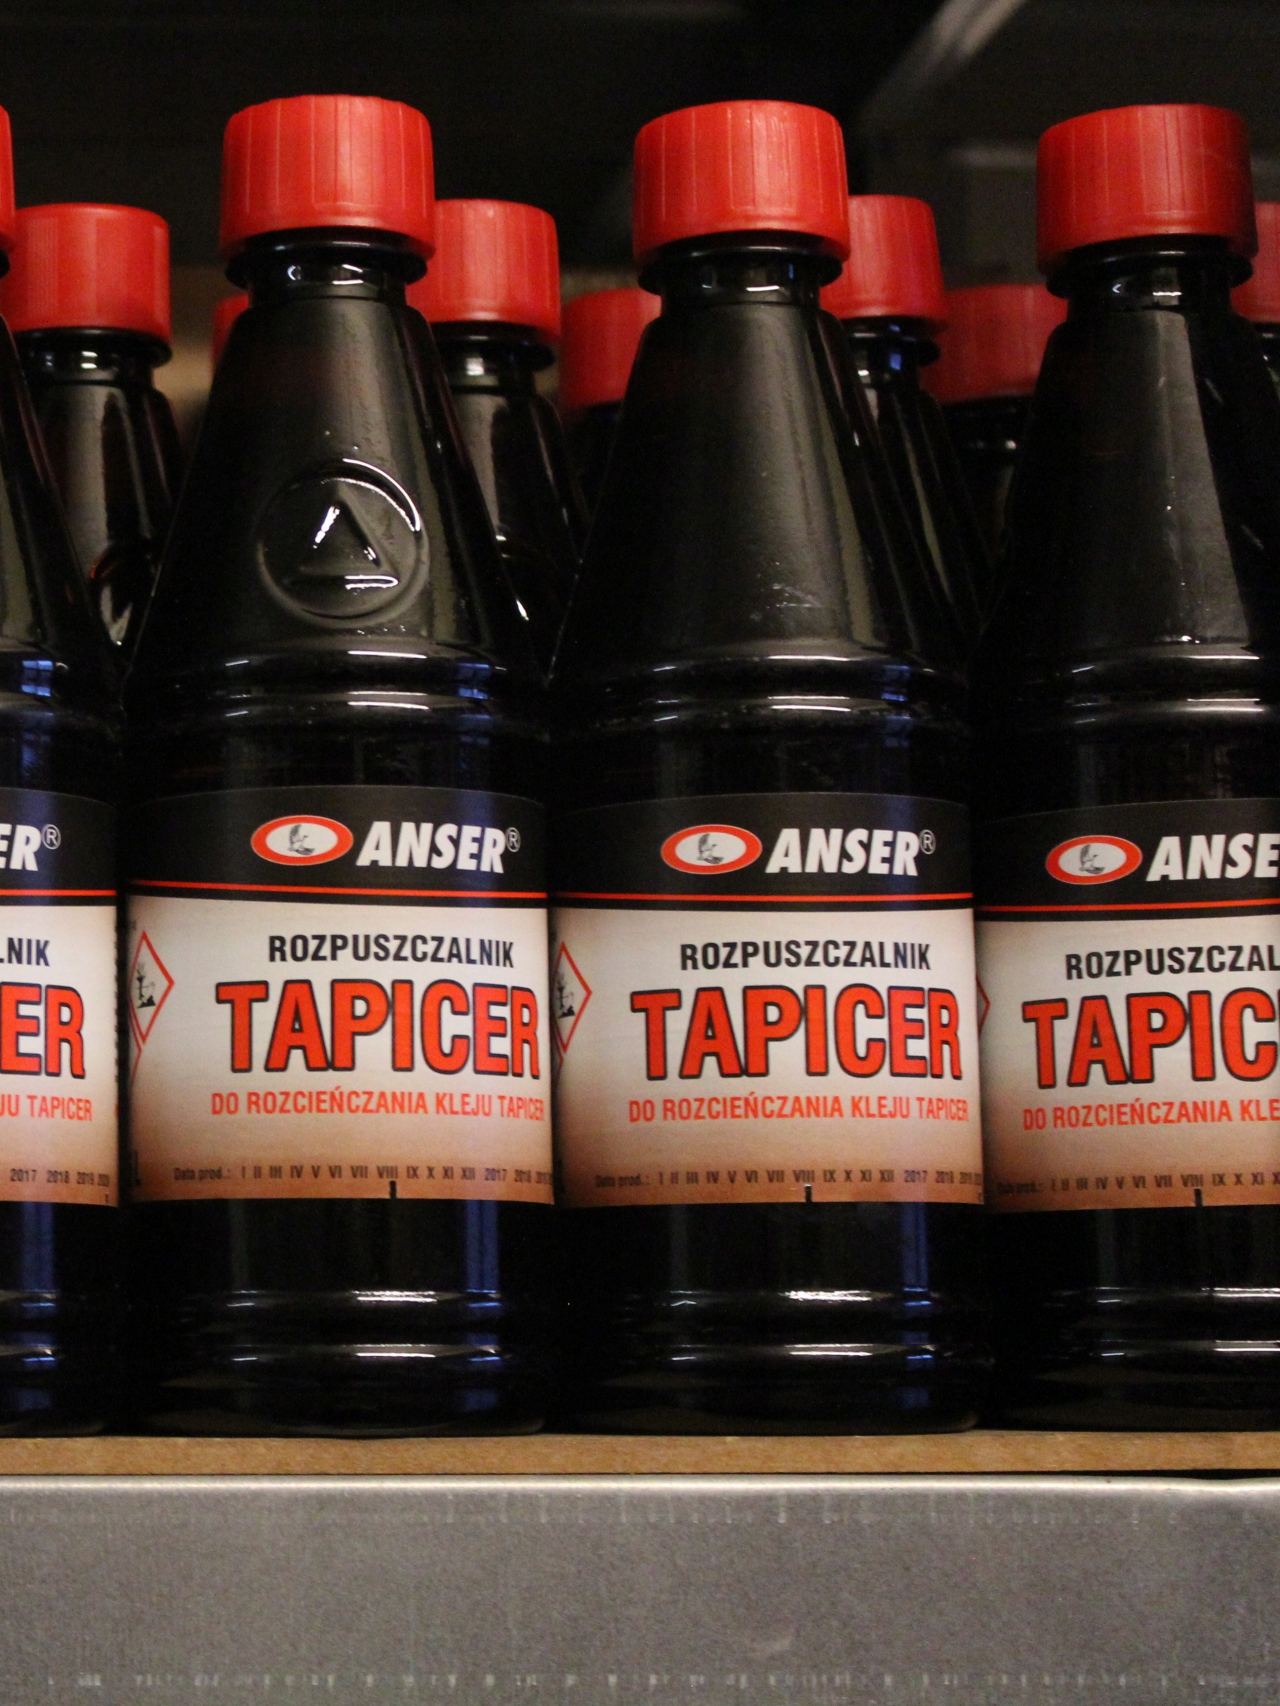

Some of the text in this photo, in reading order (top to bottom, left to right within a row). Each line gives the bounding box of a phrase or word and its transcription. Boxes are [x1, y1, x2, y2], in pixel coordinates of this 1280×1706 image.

[269, 935, 514, 968] ROZPUSZCZALNIK
[680, 939, 931, 971] ROZPUSZCZALNIK
[1065, 945, 1280, 981] ROZPUSZCZAL
[216, 979, 540, 1079] TAPICER
[630, 984, 962, 1080] TAPICER
[1022, 987, 1280, 1089] TAPIC
[27, 1094, 92, 1122] TAPICER
[211, 1086, 545, 1122] DO ROZCIEŃCZANIA KLEJU TAPICER
[629, 1092, 969, 1123] DO ROZCIEŃCZANIA KLEJU TAPICER
[1023, 1108, 1046, 1131] DO
[1053, 1098, 1232, 1129] ROZCIEŃCZANIA
[10, 1168, 37, 1183] 2017
[47, 1169, 70, 1184] 2018
[270, 1166, 282, 1179] III
[290, 1166, 303, 1179] IV
[311, 1166, 321, 1179] V
[329, 1165, 342, 1179] VI
[351, 1165, 368, 1179] VII
[376, 1166, 398, 1179] VIII
[407, 1166, 419, 1179] IX
[427, 1166, 435, 1179] X
[443, 1166, 454, 1180] XI
[461, 1167, 475, 1180] XII
[485, 1168, 507, 1182] 2017
[707, 1171, 719, 1184] IV
[728, 1170, 736, 1184] V
[745, 1170, 758, 1183] VI
[767, 1170, 784, 1183] VII
[793, 1170, 815, 1183] VIII
[823, 1170, 836, 1183] IX
[844, 1170, 852, 1183] X
[860, 1170, 872, 1183] XI
[879, 1170, 894, 1183] XII
[904, 1170, 927, 1184] 2017
[1096, 1176, 1108, 1190] IV
[1116, 1176, 1125, 1189] V
[1132, 1175, 1146, 1188] VI
[1154, 1175, 1172, 1188] VII
[1180, 1174, 1203, 1187] VIII
[1212, 1173, 1226, 1186] IX
[1234, 1173, 1242, 1186] X
[1252, 1172, 1264, 1186] XI
[1272, 1171, 1280, 1186] X
